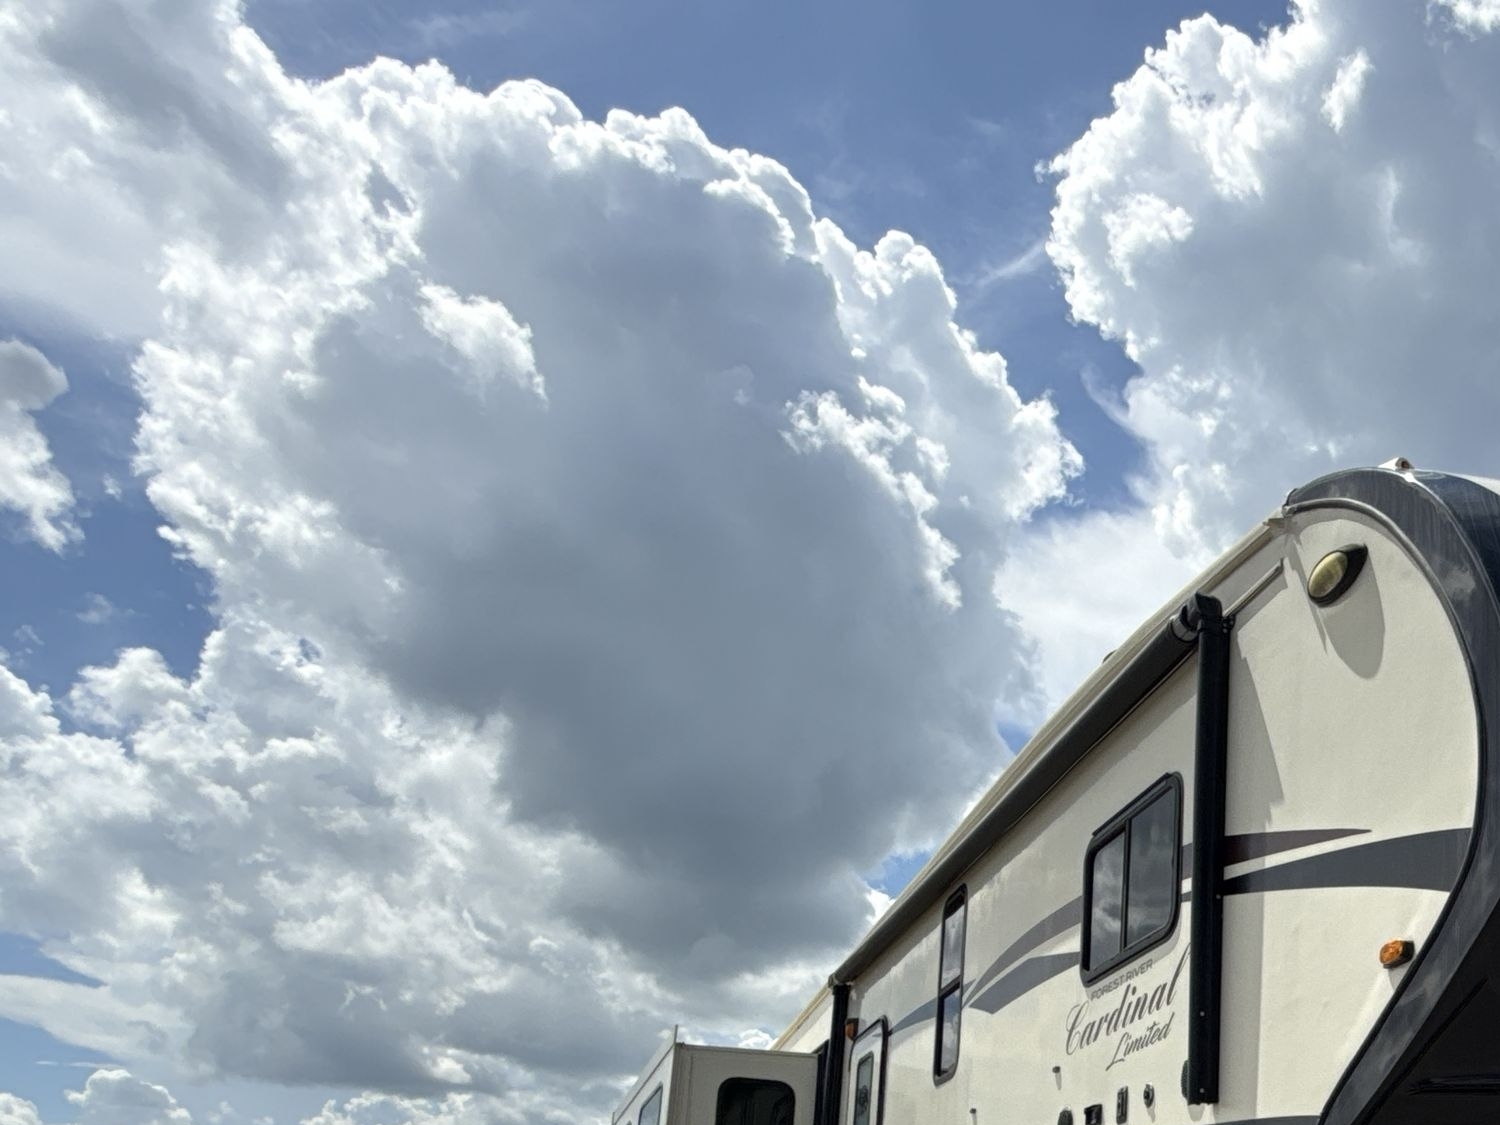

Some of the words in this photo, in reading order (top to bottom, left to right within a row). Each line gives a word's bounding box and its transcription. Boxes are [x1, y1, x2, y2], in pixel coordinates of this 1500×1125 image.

[1066, 942, 1191, 1055] Cardinal
[1090, 975, 1125, 1002] FOREST
[1125, 958, 1154, 982] RIVER
[1105, 1012, 1175, 1072] Limited
